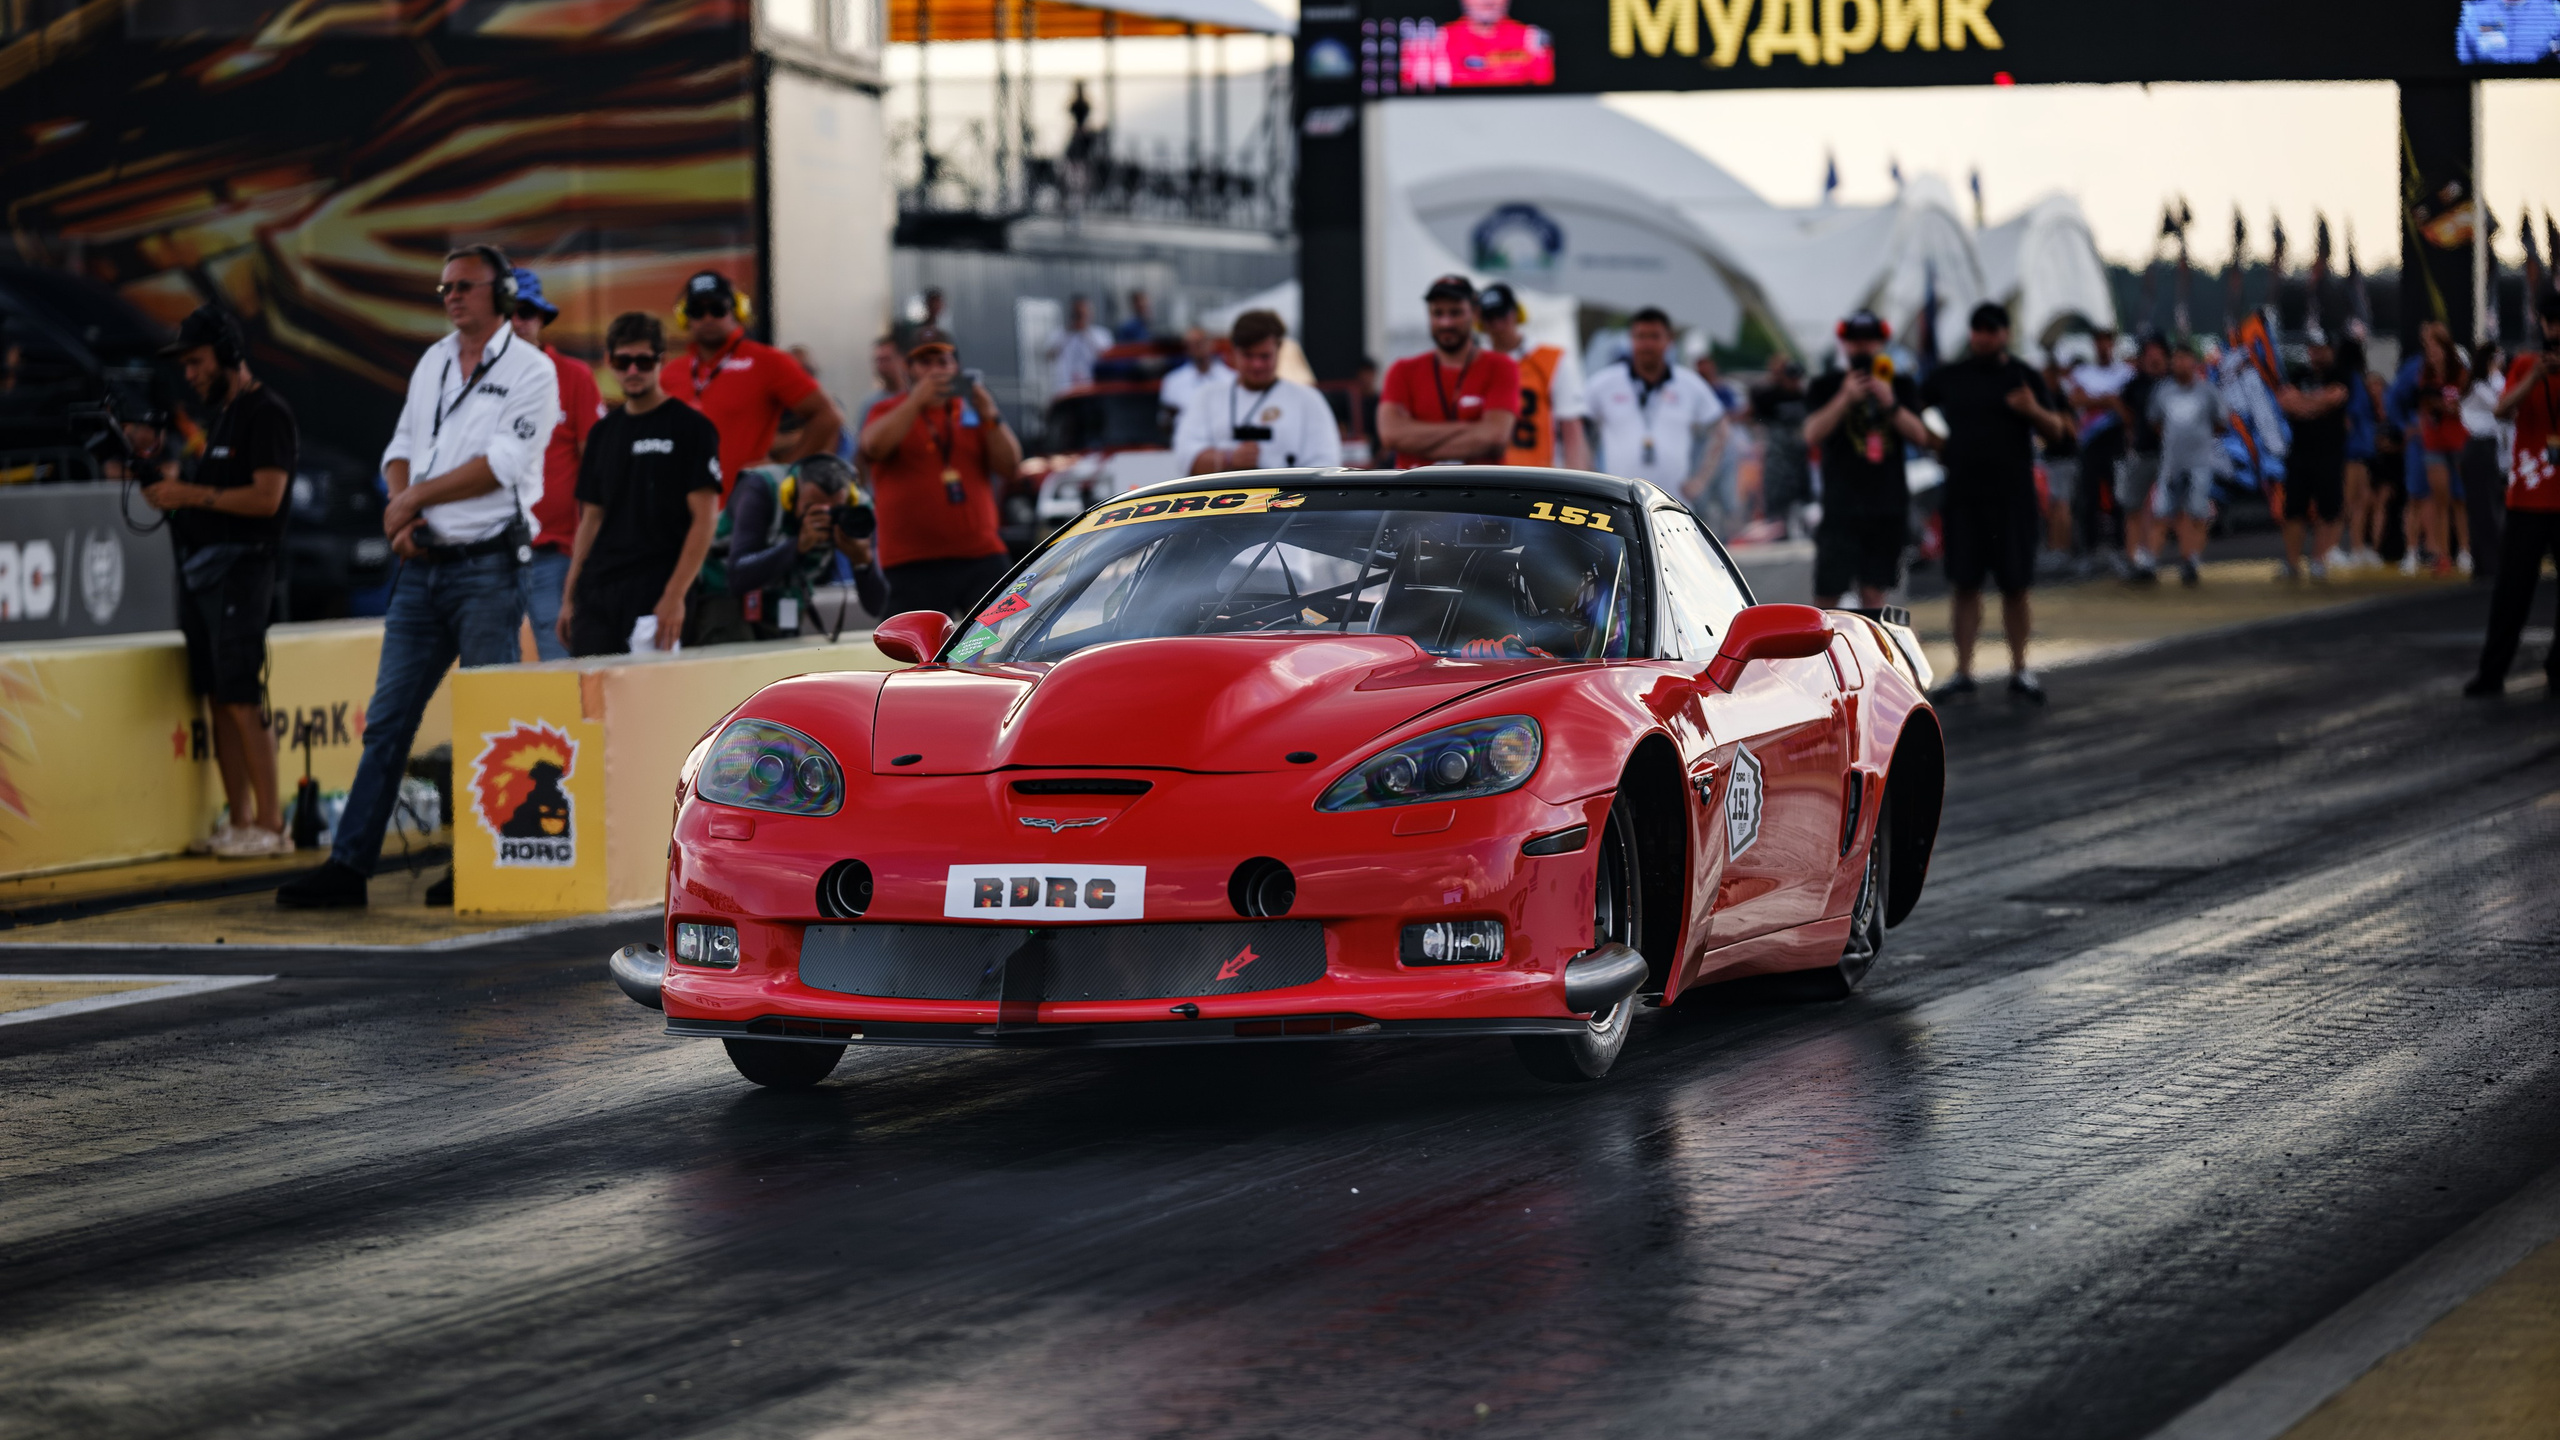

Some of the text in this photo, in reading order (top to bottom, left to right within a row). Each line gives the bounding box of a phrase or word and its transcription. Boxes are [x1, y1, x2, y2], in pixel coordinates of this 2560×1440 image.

[1608, 0, 2005, 68] Мудрик
[1093, 491, 1250, 528] RDRC
[1528, 501, 1615, 533] 151
[981, 607, 1017, 618] ALCOHOL
[957, 644, 983, 653] SYSTEM
[961, 635, 990, 646] NITROUS
[962, 641, 982, 649] OXIDE
[1732, 788, 1749, 821] 151
[973, 876, 1116, 909] RDRC
